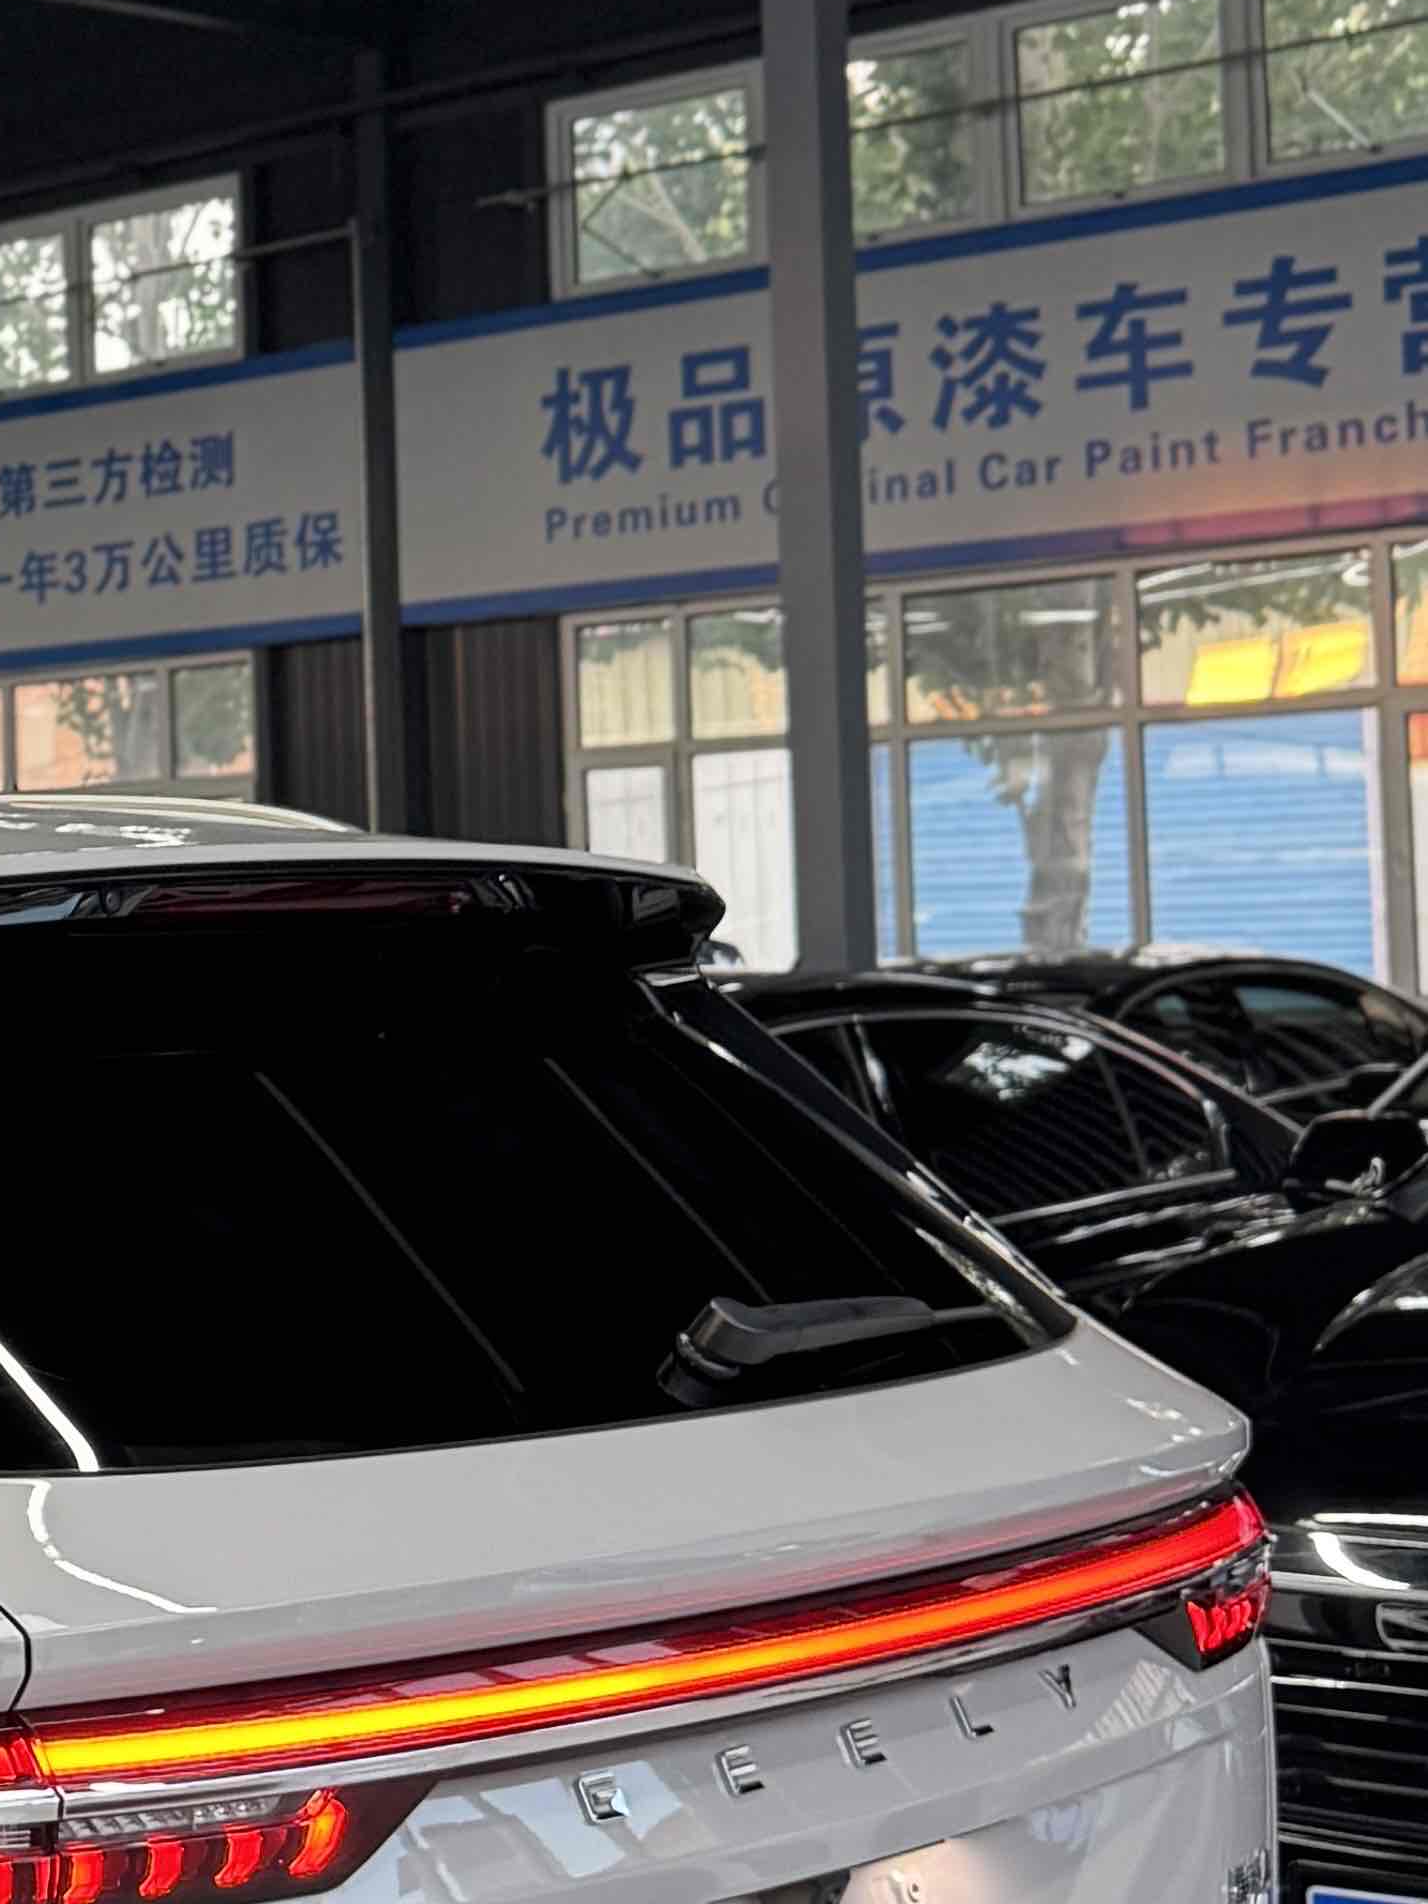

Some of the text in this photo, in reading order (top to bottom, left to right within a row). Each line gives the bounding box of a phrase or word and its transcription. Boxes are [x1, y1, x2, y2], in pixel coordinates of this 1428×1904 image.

[546, 490, 742, 543] Premium
[763, 460, 955, 516] Oinal
[978, 451, 1062, 492] Car
[1085, 429, 1220, 479] Paint
[572, 1663, 1077, 1827] GEELY
